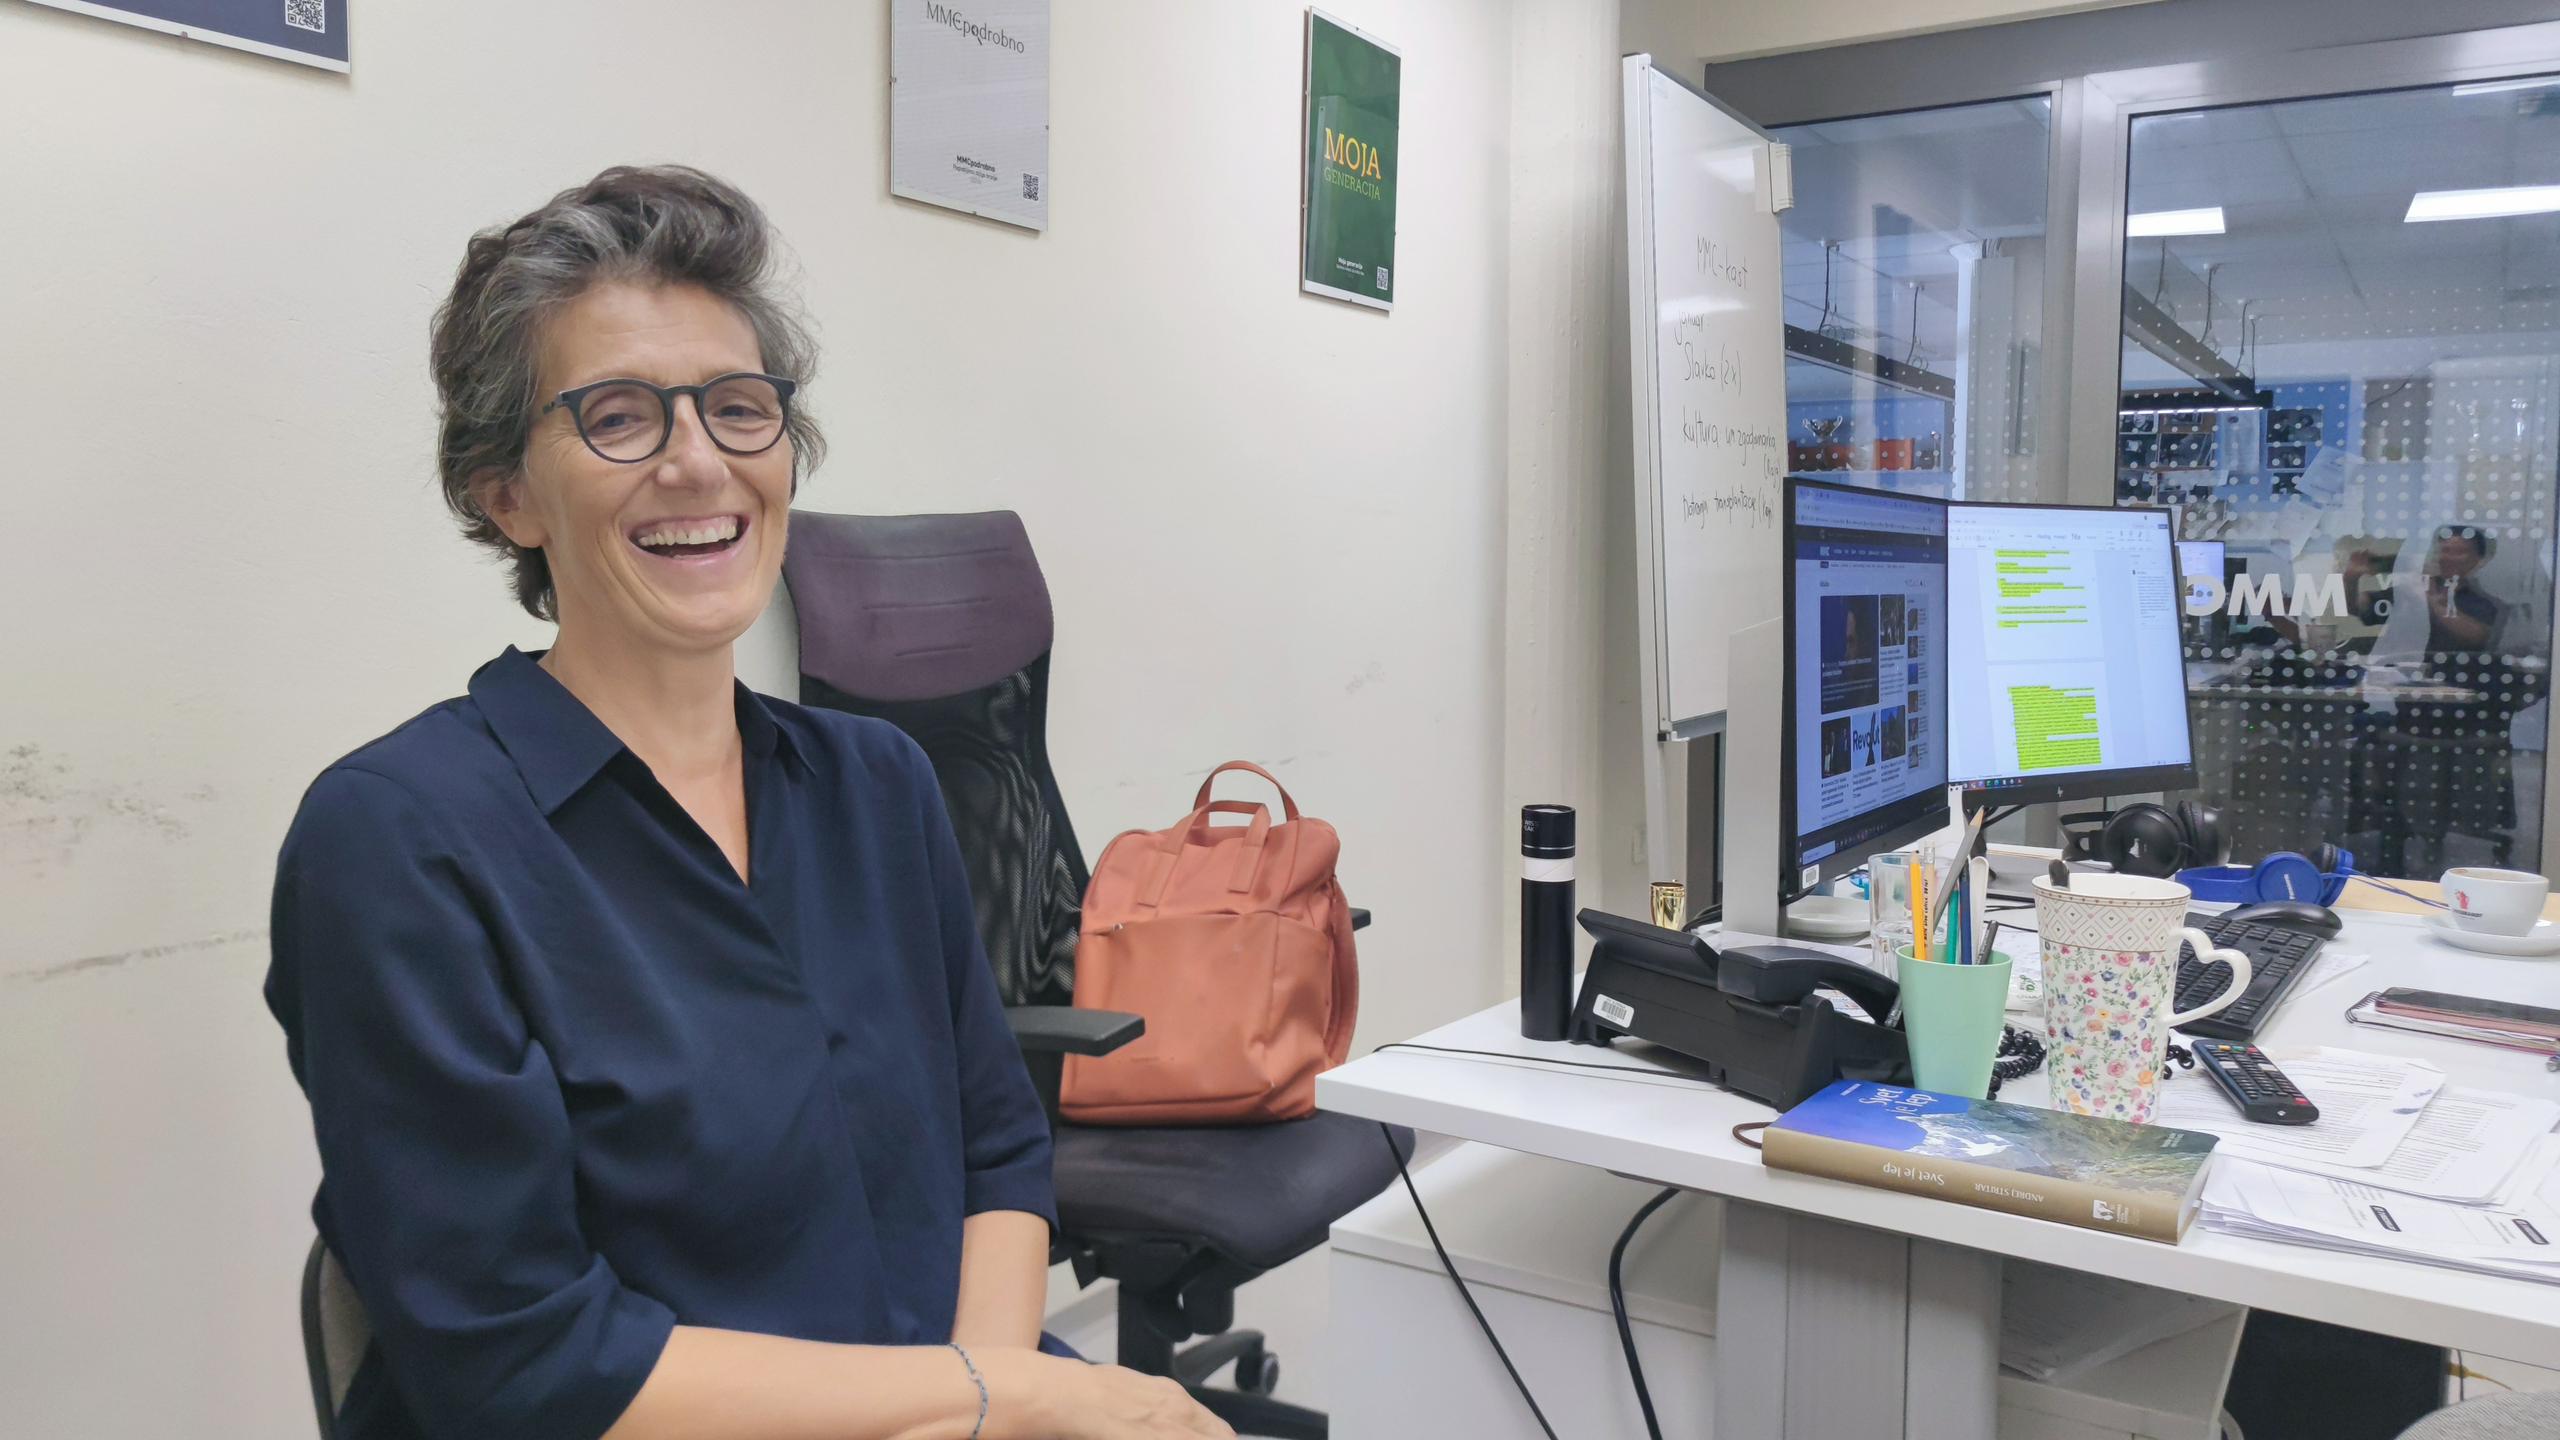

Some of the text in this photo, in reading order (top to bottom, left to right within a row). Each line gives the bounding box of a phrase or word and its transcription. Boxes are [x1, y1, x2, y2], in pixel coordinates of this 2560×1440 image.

[1324, 128, 1381, 180] MOJA
[1324, 166, 1381, 200] GENERACIJA
[1853, 724, 1880, 752] Revout
[1858, 1088, 1904, 1106] Svet
[1882, 1162, 1945, 1186] Svet je lep
[1974, 1183, 2045, 1203] ANDREJ STRITAR
